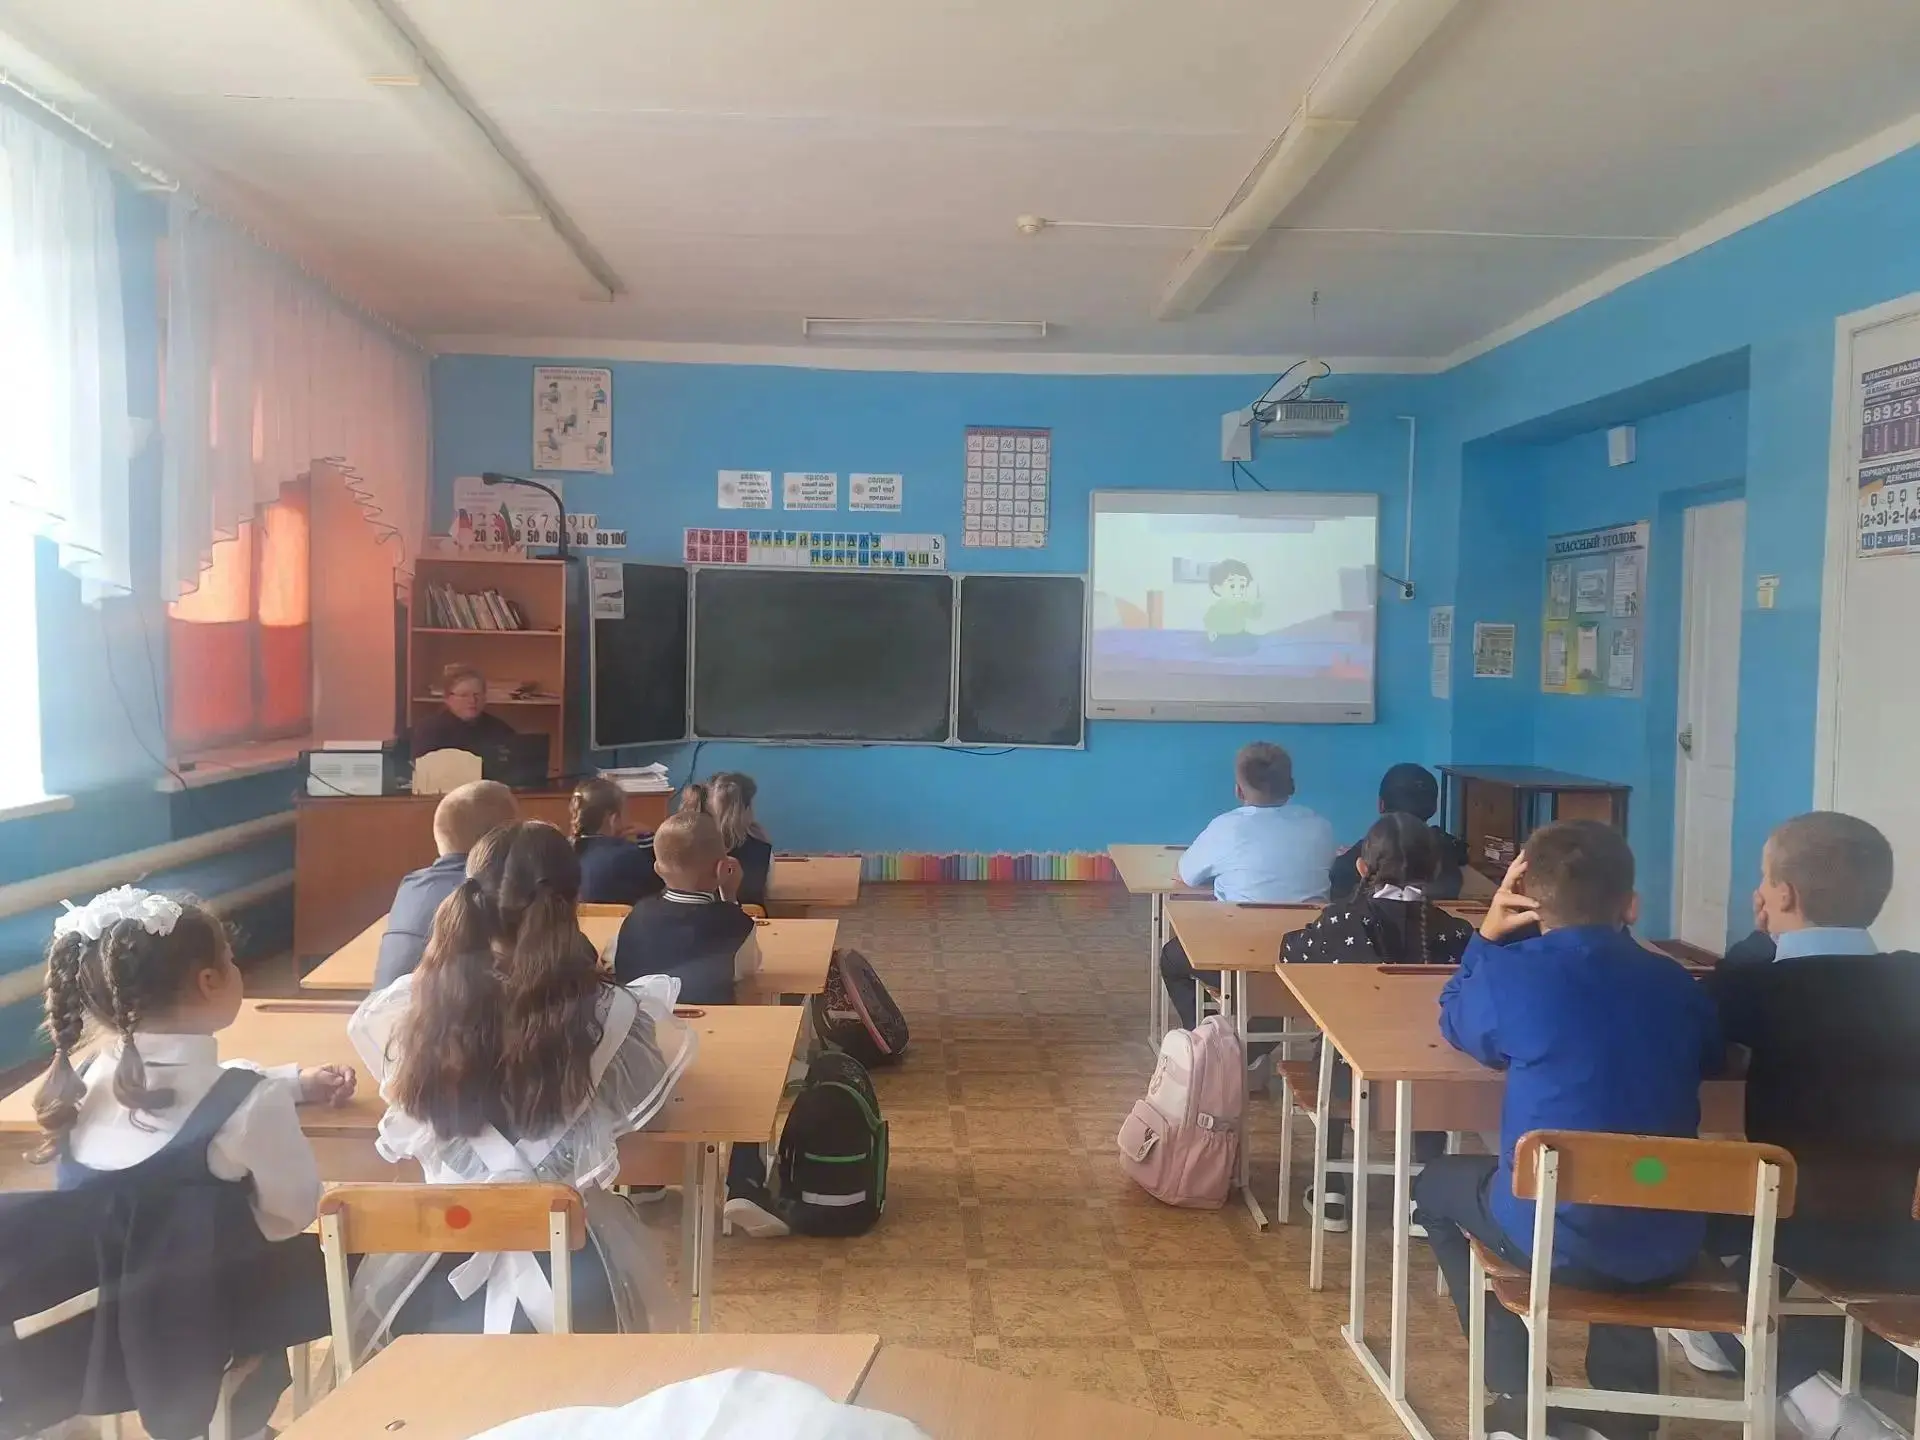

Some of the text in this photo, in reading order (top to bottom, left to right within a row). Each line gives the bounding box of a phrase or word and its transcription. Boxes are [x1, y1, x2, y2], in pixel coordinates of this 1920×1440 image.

[527, 514, 536, 528] 6
[581, 516, 598, 530] 10
[474, 530, 487, 543] 20
[527, 530, 540, 543] 50
[545, 531, 558, 544] 60
[576, 531, 589, 545] 80
[596, 533, 609, 545] 90
[611, 532, 627, 545] 100
[1555, 531, 1637, 554] КЛАССНЫЙ УГОЛОК
